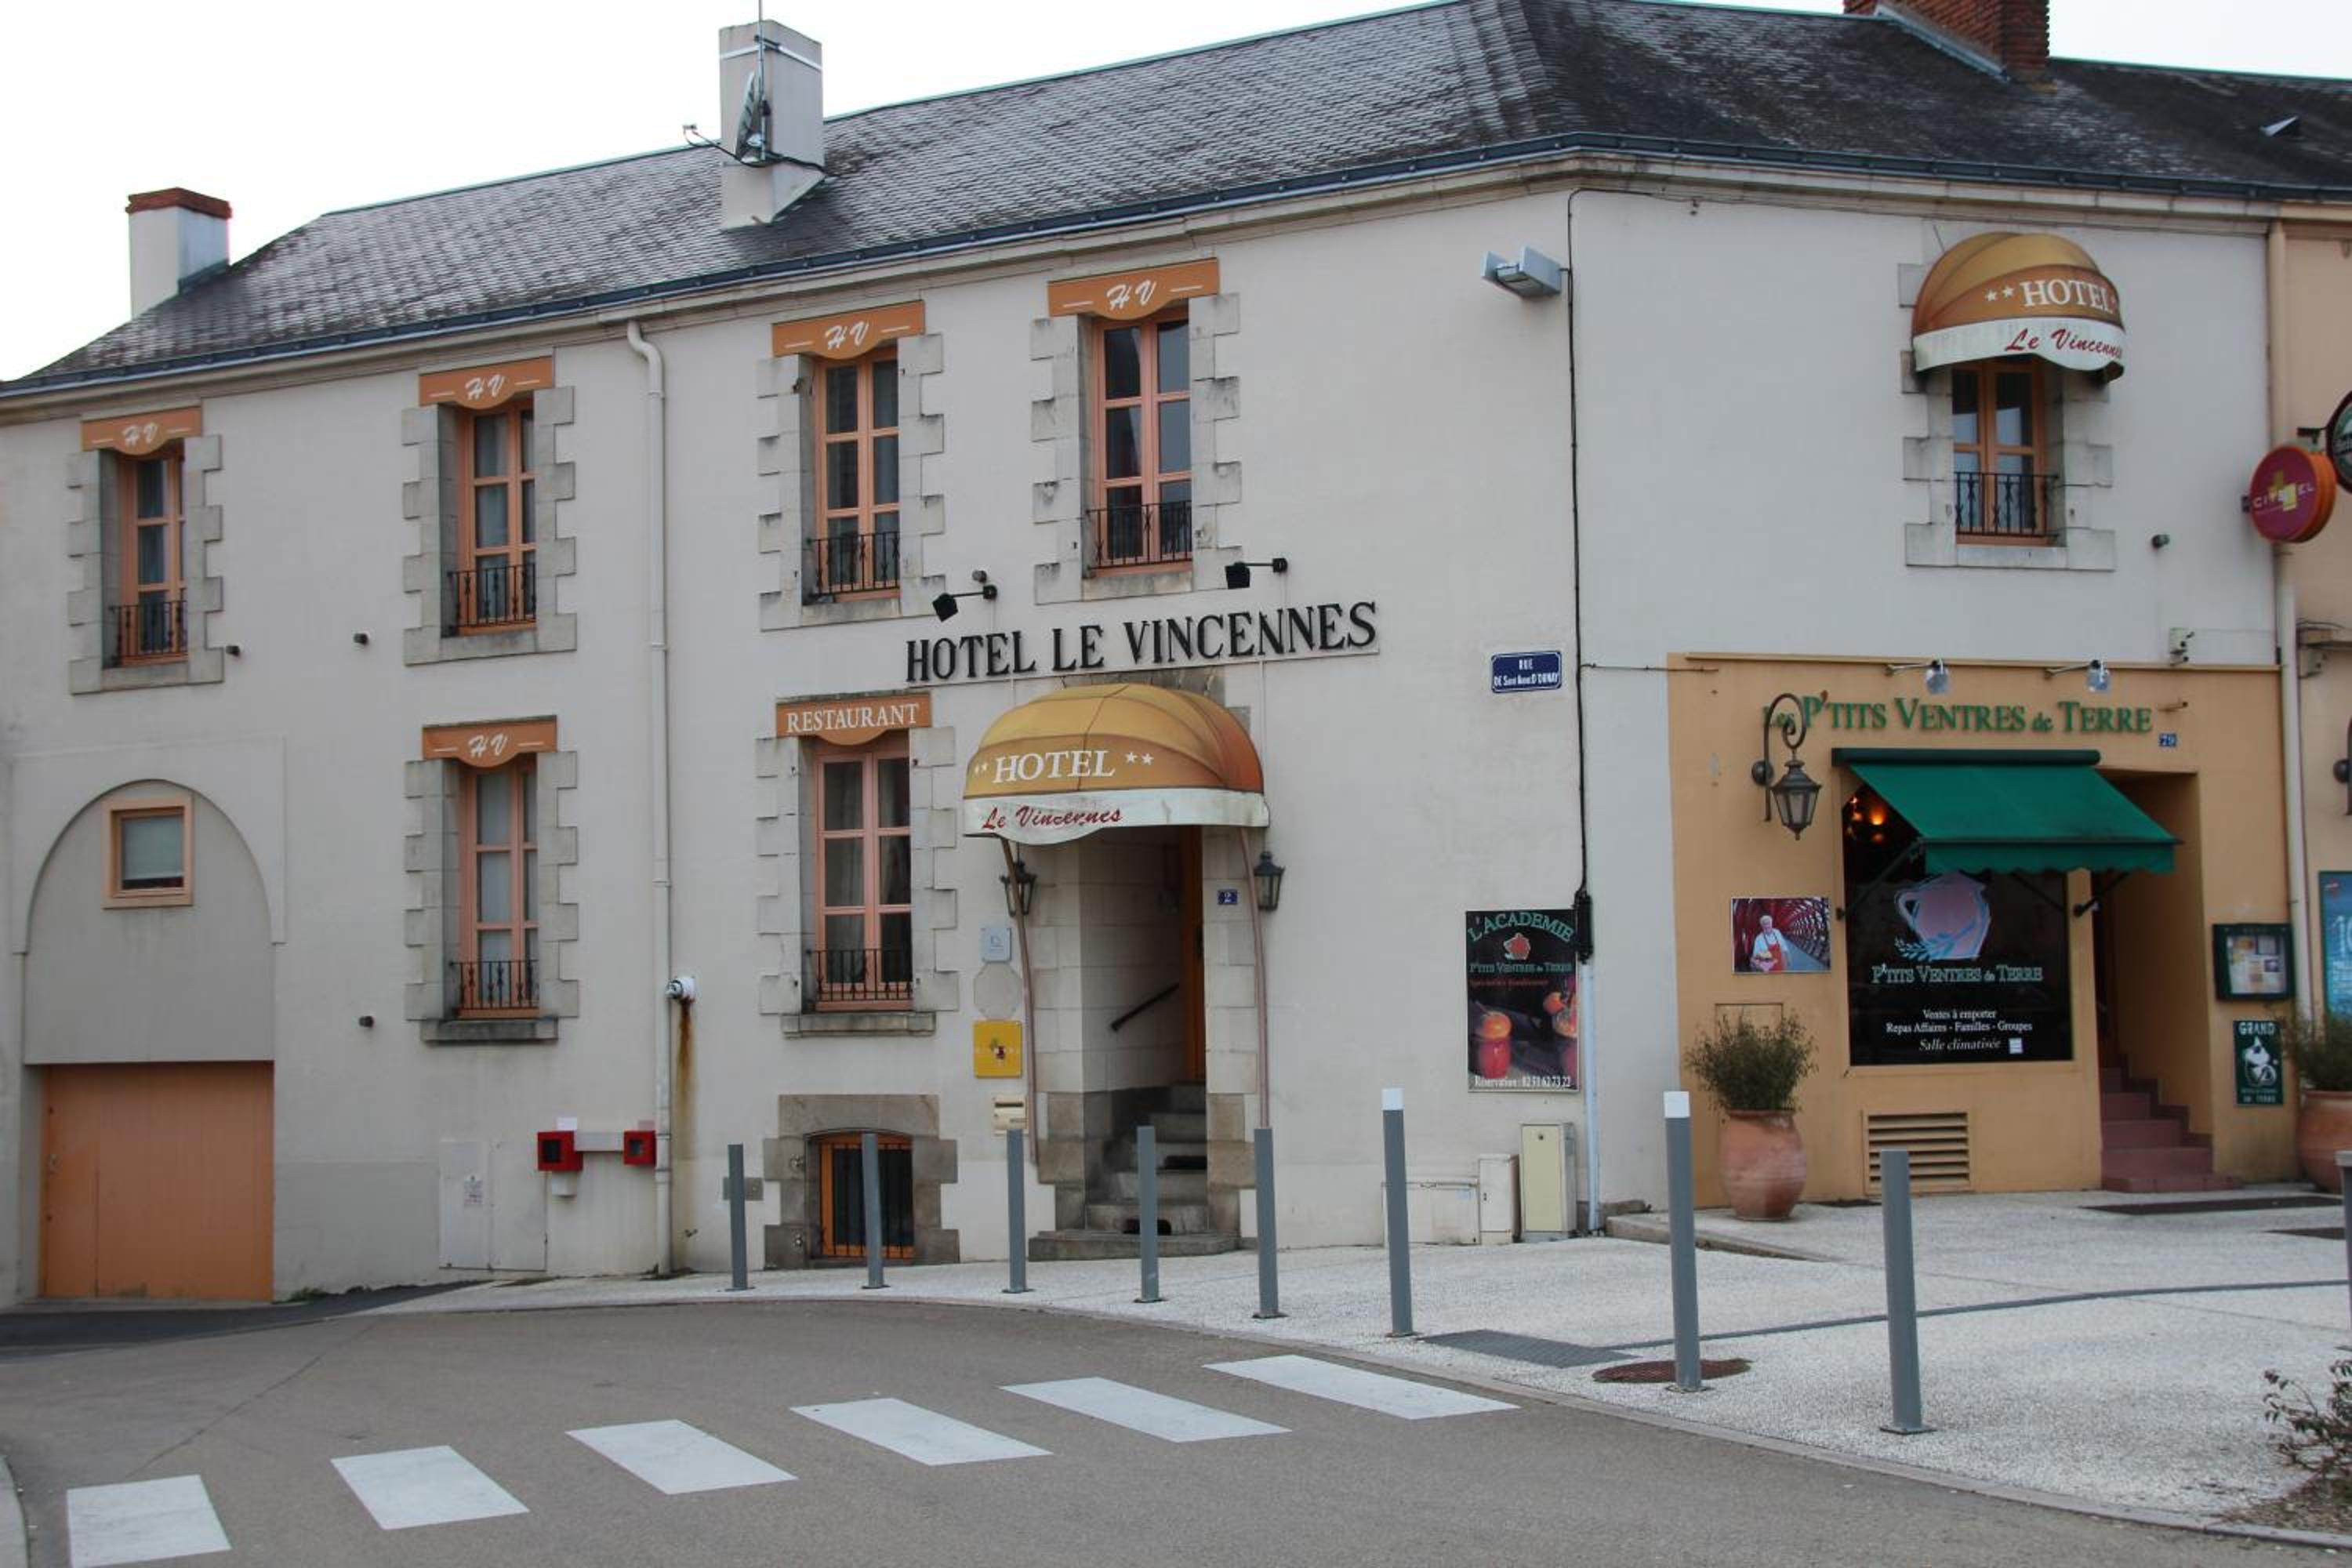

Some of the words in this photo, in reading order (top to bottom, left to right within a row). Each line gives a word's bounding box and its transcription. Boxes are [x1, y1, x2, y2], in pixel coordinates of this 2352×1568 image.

[2020, 278, 2114, 314] HOTEL
[2005, 328, 2039, 352] Le
[2050, 328, 2122, 359] Vincenne
[906, 630, 1036, 682] HOTEL
[1051, 624, 1105, 672] LE
[1123, 601, 1377, 665] VINCENNES
[786, 703, 919, 732] RESTAURANT
[1893, 697, 2027, 733] VENTRES
[2057, 700, 2154, 734] TERRE
[992, 750, 1117, 784] HOTEL
[982, 807, 1007, 830] Le
[1015, 804, 1123, 828] Vincennes
[1224, 892, 1232, 903] 2
[1917, 964, 1982, 983] VENTRES
[1996, 964, 2043, 982] TERRE
[1886, 1023, 1912, 1035] Repas
[1914, 1022, 1947, 1033] Affaires
[1955, 1022, 1991, 1032] Familles
[1997, 1021, 2033, 1033] Groupes
[1922, 1009, 1951, 1019] Ventes
[1960, 1009, 1997, 1022] emporter
[2239, 1022, 2276, 1036] GRAND
[1919, 1038, 1945, 1051] Salle
[1947, 1037, 2002, 1050] climatisée
